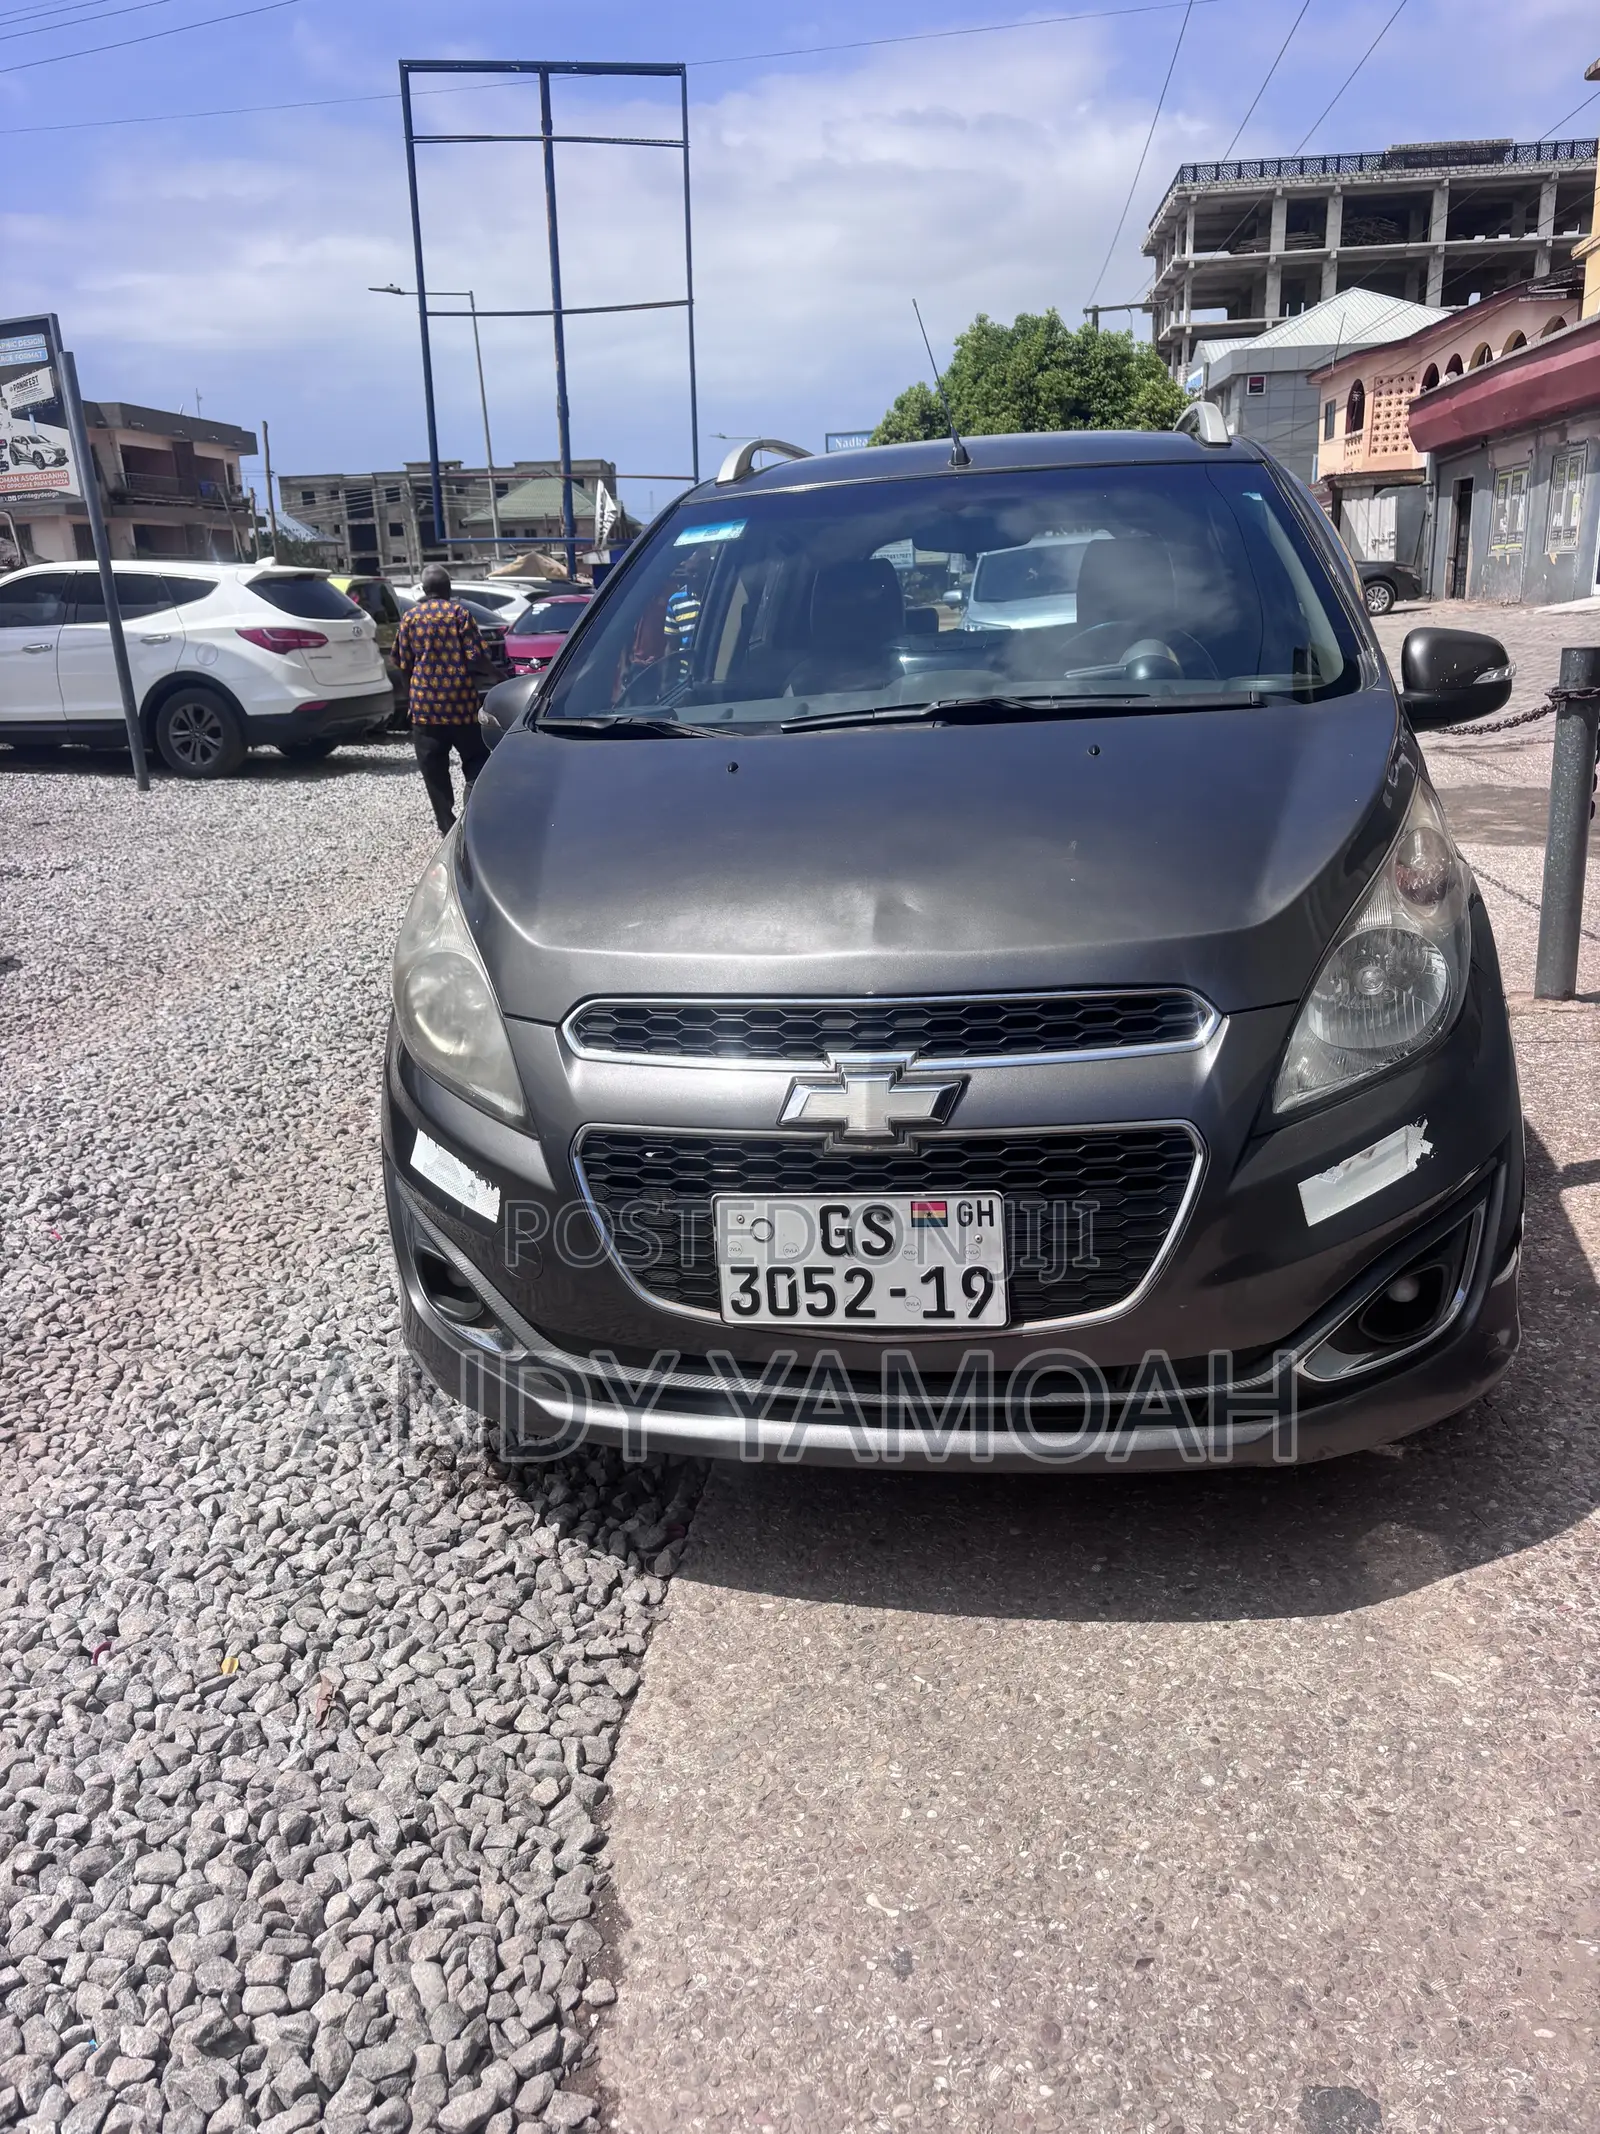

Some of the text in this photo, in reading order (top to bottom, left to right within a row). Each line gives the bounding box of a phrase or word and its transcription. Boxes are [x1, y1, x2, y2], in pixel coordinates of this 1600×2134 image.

[15, 351, 42, 360] FORMAT
[957, 1199, 995, 1227] GH
[820, 1203, 894, 1256] GS
